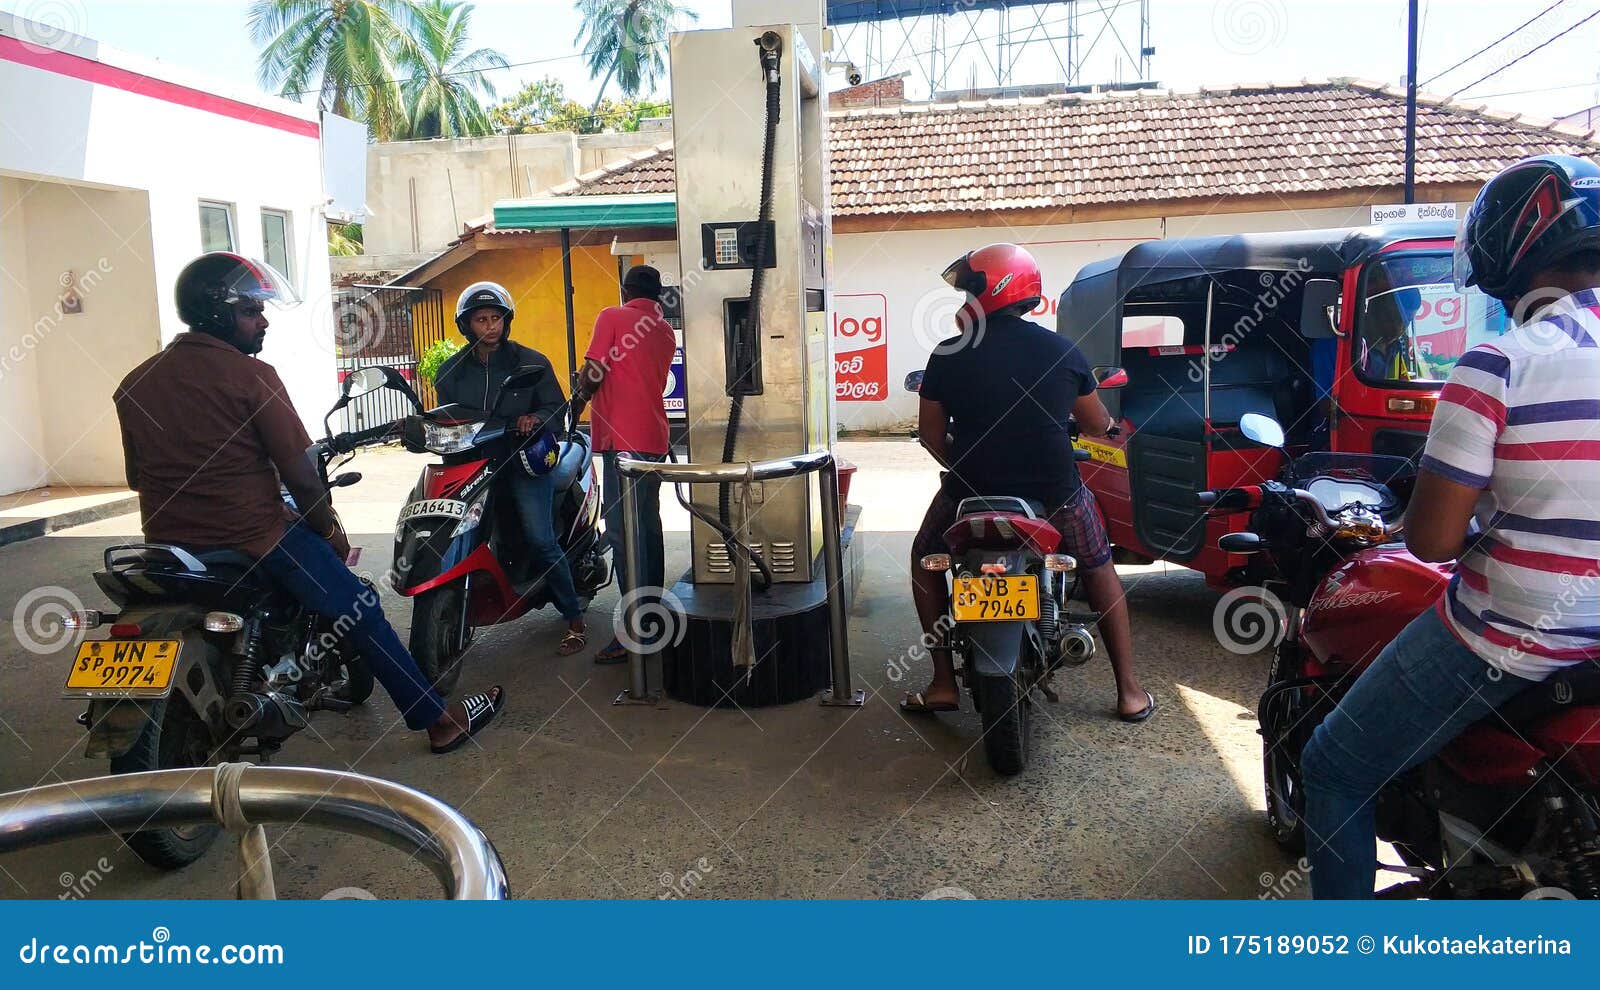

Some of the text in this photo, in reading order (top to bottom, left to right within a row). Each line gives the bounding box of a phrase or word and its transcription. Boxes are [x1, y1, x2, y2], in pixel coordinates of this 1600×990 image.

[982, 578, 1009, 597] VB
[979, 599, 1026, 618] 7946
[113, 642, 147, 663] WN
[78, 657, 105, 672] SP
[101, 665, 156, 685] 9974
